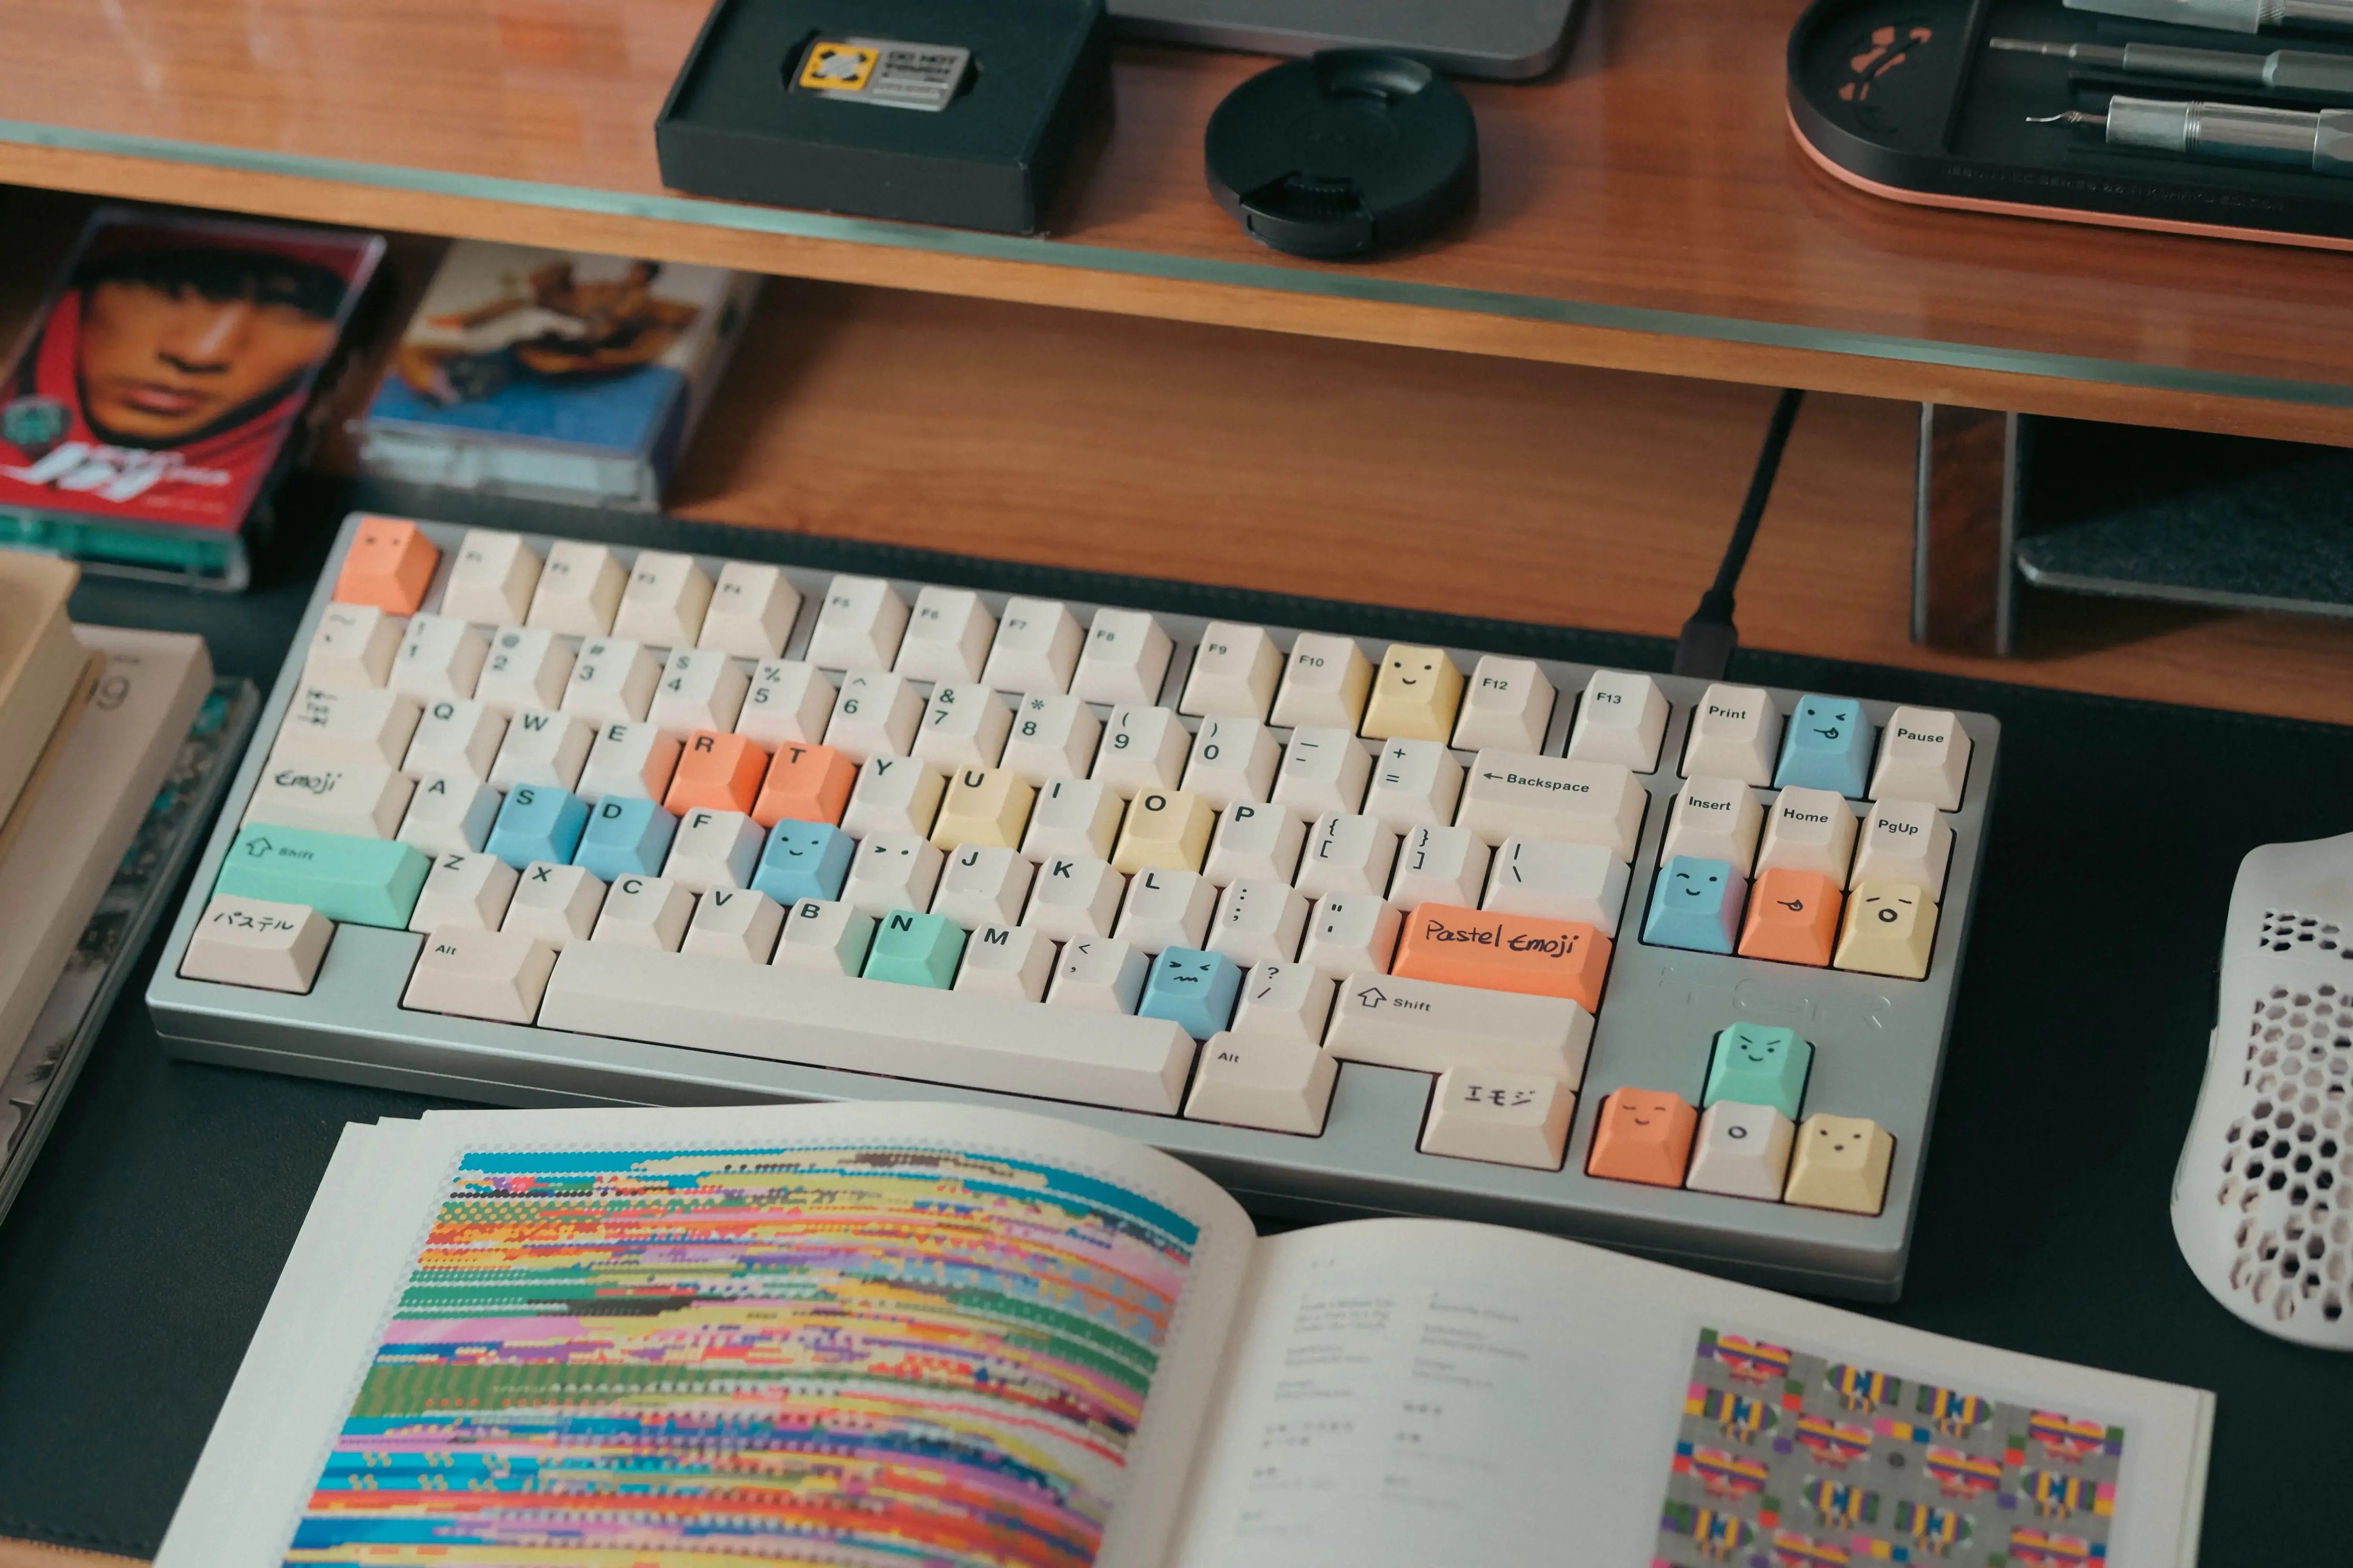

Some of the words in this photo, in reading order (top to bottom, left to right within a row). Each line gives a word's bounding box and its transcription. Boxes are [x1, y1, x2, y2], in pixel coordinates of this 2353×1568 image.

[723, 583, 741, 594] F4
[832, 596, 849, 608] F5
[920, 608, 939, 620] F6
[1008, 619, 1027, 630] F7
[1096, 630, 1115, 642] F8
[1209, 643, 1227, 654] F9
[492, 655, 508, 671] 2
[1299, 654, 1324, 667] F10
[579, 665, 595, 681] 3
[764, 666, 781, 683] %
[668, 677, 681, 692] 4
[1482, 677, 1508, 690] F12
[754, 687, 769, 703] 5
[939, 689, 955, 704] &
[1596, 692, 1622, 704] F13
[433, 703, 454, 720] Q
[843, 699, 859, 714] 6
[1709, 705, 1746, 719] Print
[524, 714, 548, 732] W
[934, 710, 949, 725] 7
[1122, 712, 1129, 727] (
[608, 725, 626, 742] E
[1022, 721, 1037, 736] 8
[1210, 722, 1218, 737] )
[1897, 728, 1944, 743] Pause
[694, 736, 715, 753] R
[1114, 734, 1130, 749] 9
[790, 747, 807, 764] T
[1203, 744, 1219, 760] 0
[1393, 748, 1406, 758] +
[877, 758, 893, 776] Y
[274, 771, 342, 795] Emoji
[964, 770, 985, 788] U
[1385, 774, 1400, 783] =
[1507, 773, 1590, 793] Backspace
[428, 780, 445, 795] A
[1052, 783, 1061, 798] I
[516, 790, 535, 805] S
[1144, 795, 1167, 812] O
[1688, 796, 1731, 811] Insert
[602, 803, 622, 819] D
[1235, 806, 1255, 822] P
[1783, 807, 1828, 823] Home
[692, 814, 712, 828] F
[1329, 818, 1339, 836] {
[1878, 819, 1918, 835] PgUp
[1419, 829, 1429, 847] }
[1320, 839, 1333, 858] [
[443, 854, 465, 871] Z
[961, 851, 979, 866] J
[1413, 851, 1425, 870] ]
[532, 866, 552, 882] X
[1053, 861, 1073, 878] K
[622, 879, 642, 894] C
[1145, 873, 1160, 890] L
[716, 891, 733, 906] V
[1239, 888, 1248, 901] :
[800, 903, 820, 919] B
[1232, 908, 1241, 922] ;
[213, 912, 294, 932] パステル
[890, 915, 913, 932] N
[983, 928, 1010, 946] M
[1426, 919, 1503, 947] Pastel
[1507, 934, 1580, 958] Emoji
[435, 945, 456, 955] Alt
[1078, 943, 1091, 955] <
[1267, 966, 1280, 980] ?
[1257, 987, 1271, 999] /
[1393, 998, 1431, 1011] Shift
[1218, 1052, 1239, 1063] Alt
[1464, 1086, 1535, 1107] エモジ
